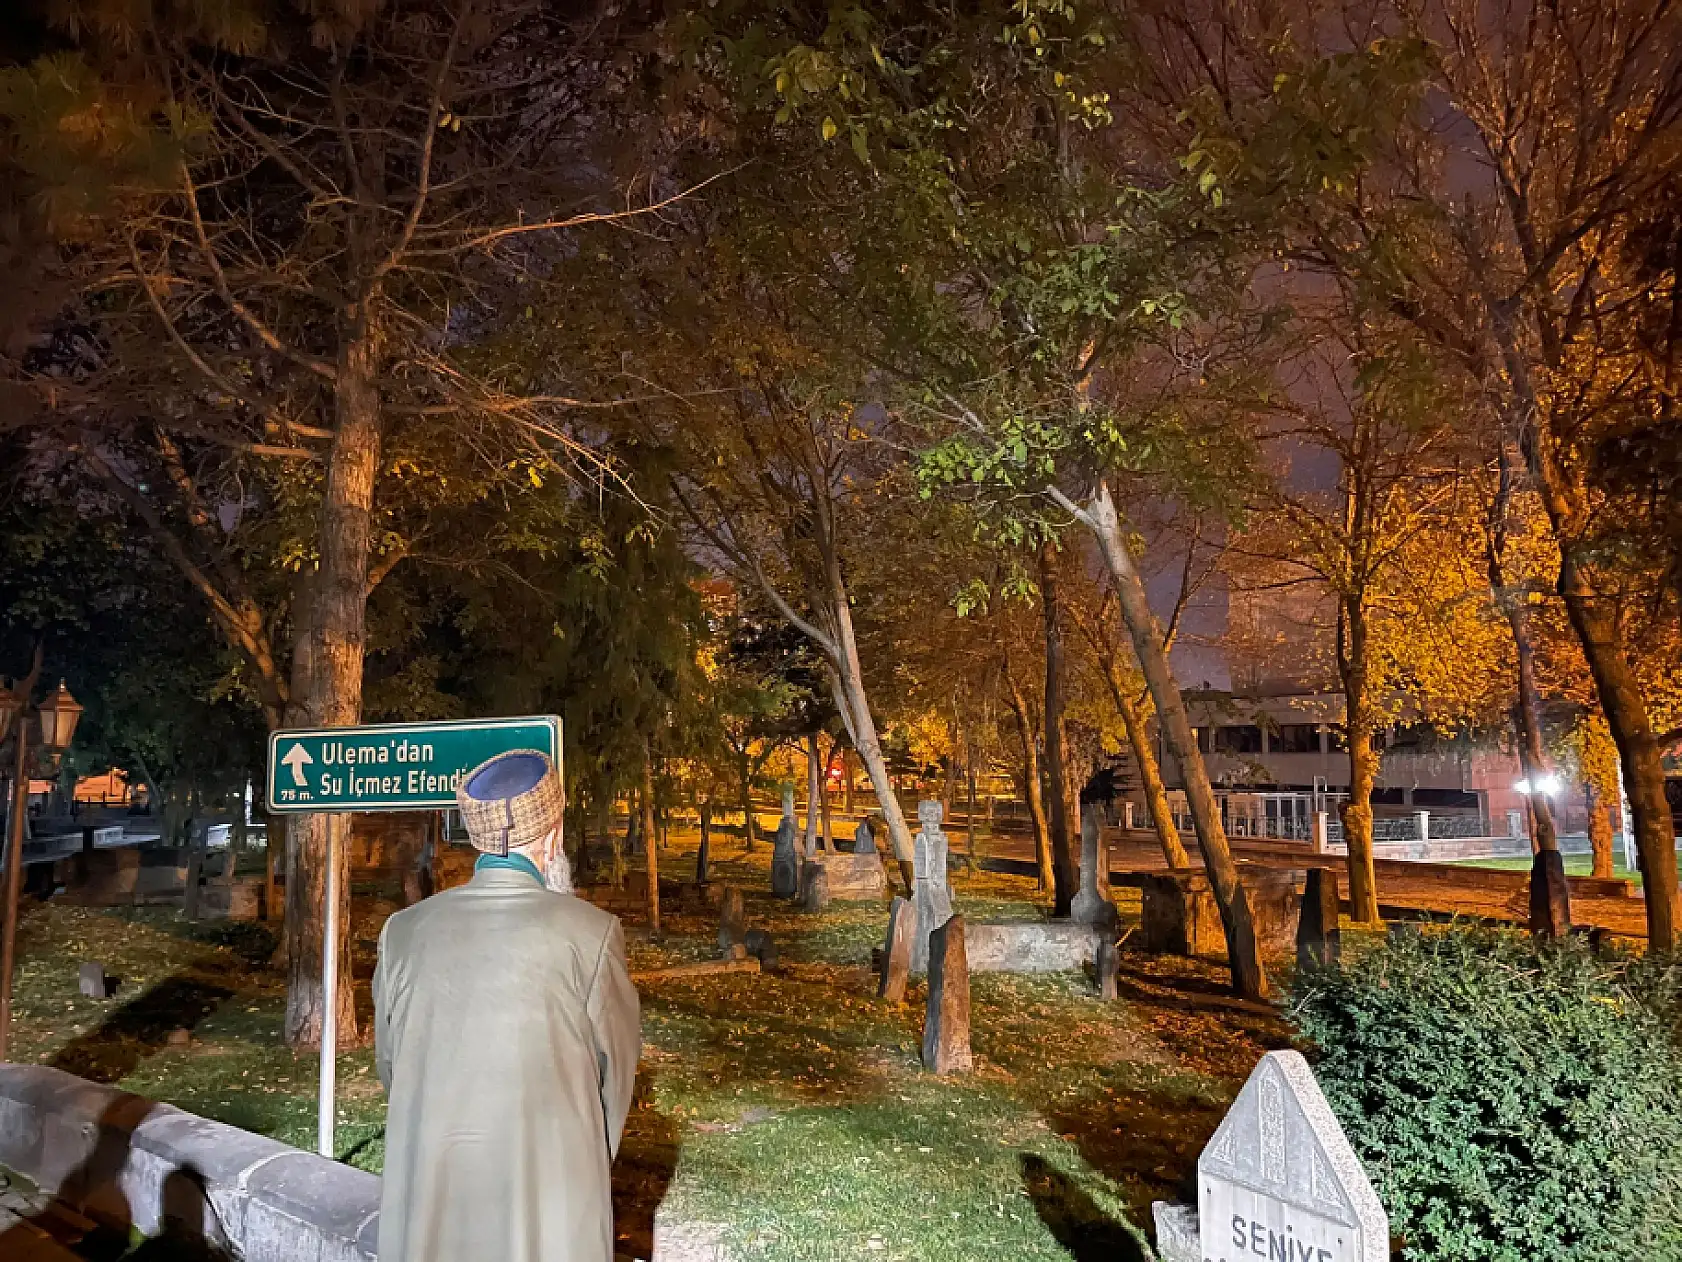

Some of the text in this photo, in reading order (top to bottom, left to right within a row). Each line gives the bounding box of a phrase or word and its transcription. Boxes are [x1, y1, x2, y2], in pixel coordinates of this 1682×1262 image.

[321, 740, 434, 765] Ulema'dan
[320, 767, 467, 799] Su İçmez Efend
